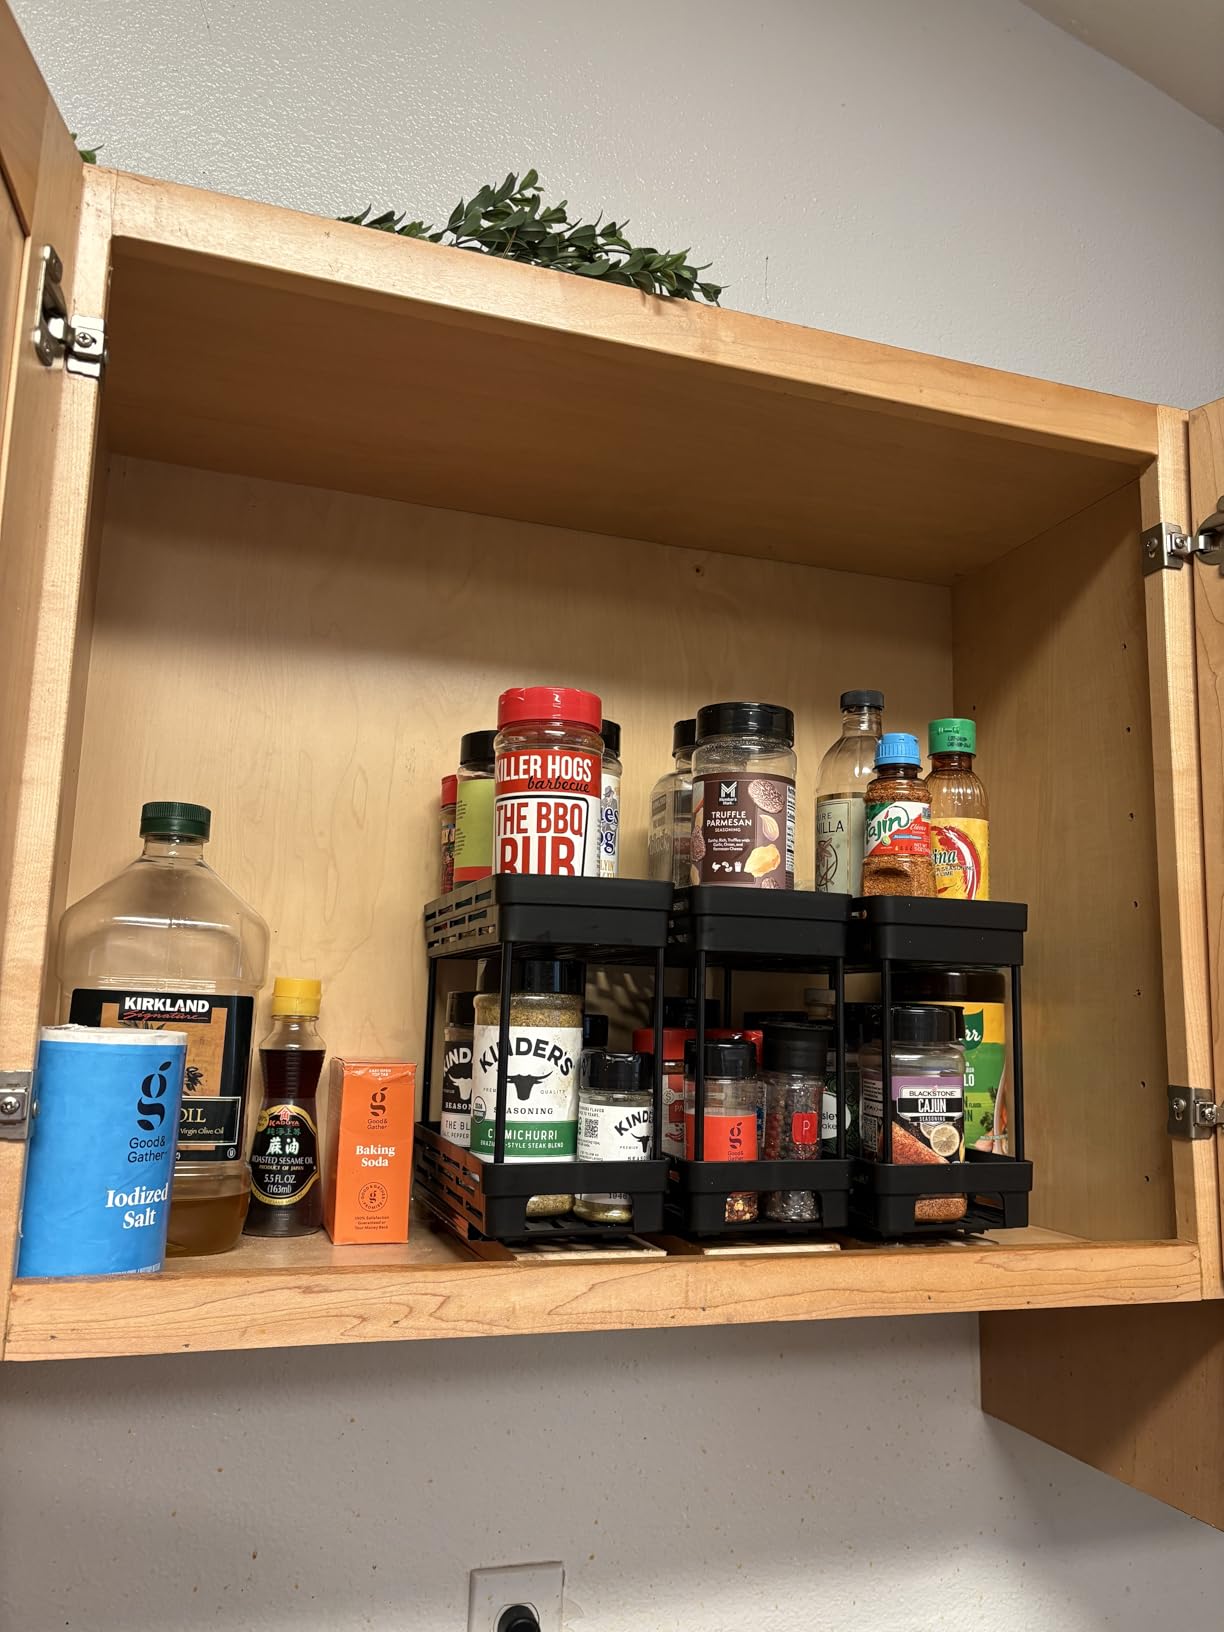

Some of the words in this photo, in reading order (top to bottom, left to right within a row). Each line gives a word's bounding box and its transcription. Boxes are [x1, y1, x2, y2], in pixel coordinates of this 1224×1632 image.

[547, 755, 592, 783] HOGS
[527, 776, 590, 793] barbecue
[496, 802, 529, 837] THE
[536, 802, 583, 837] BBQ
[711, 811, 747, 819] TRUFFLE
[706, 819, 752, 827] PARMESAN
[124, 996, 210, 1013] KIRKLAND
[123, 1009, 209, 1020] Signature
[494, 1107, 554, 1115] SASONING
[917, 1098, 947, 1113] CAJUN
[269, 1119, 300, 1127] KADOYA
[445, 1119, 457, 1130] THE
[180, 1127, 197, 1137] Virgin
[197, 1126, 214, 1135] Olive
[214, 1126, 225, 1135] Oil
[487, 1129, 558, 1141] CMICHURRI
[129, 1136, 166, 1150] Good&
[355, 1144, 396, 1157] Baking
[127, 1151, 166, 1163] Gather
[279, 1156, 304, 1165] SESAME
[304, 1156, 314, 1165] OIL
[361, 1156, 389, 1167] Soda
[264, 1173, 274, 1183] 5.5
[267, 1184, 292, 1194] (163ml)
[105, 1183, 169, 1208] Iodized
[122, 1207, 156, 1229] Salt
